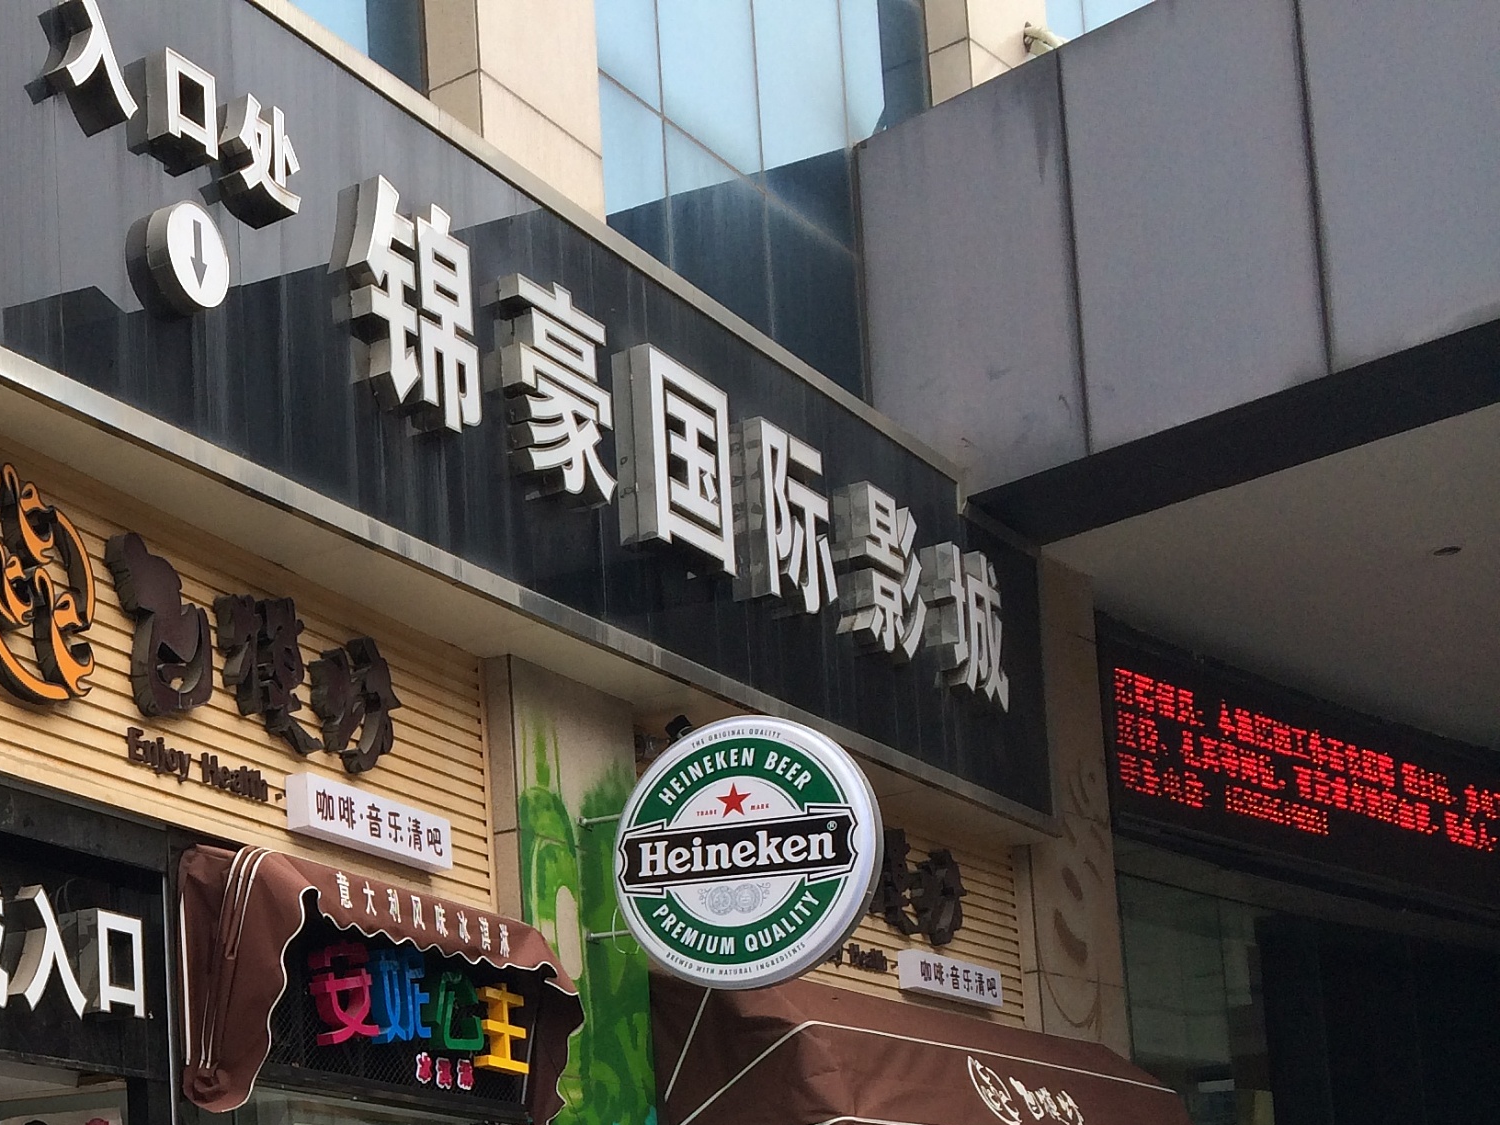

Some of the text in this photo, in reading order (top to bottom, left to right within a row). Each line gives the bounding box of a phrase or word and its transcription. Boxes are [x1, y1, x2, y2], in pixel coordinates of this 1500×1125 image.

[62, 0, 301, 214] 入口处
[360, 175, 1008, 712] 锦豪国际影城
[127, 726, 270, 802] Enjoy Health
[657, 747, 813, 806] HEINEKEN BEER
[637, 830, 837, 878] Heineken
[334, 870, 511, 959] 意大利风味冰淇淋
[652, 889, 821, 956] PREMIUM QUALITY
[308, 942, 530, 1075] 安妮公主
